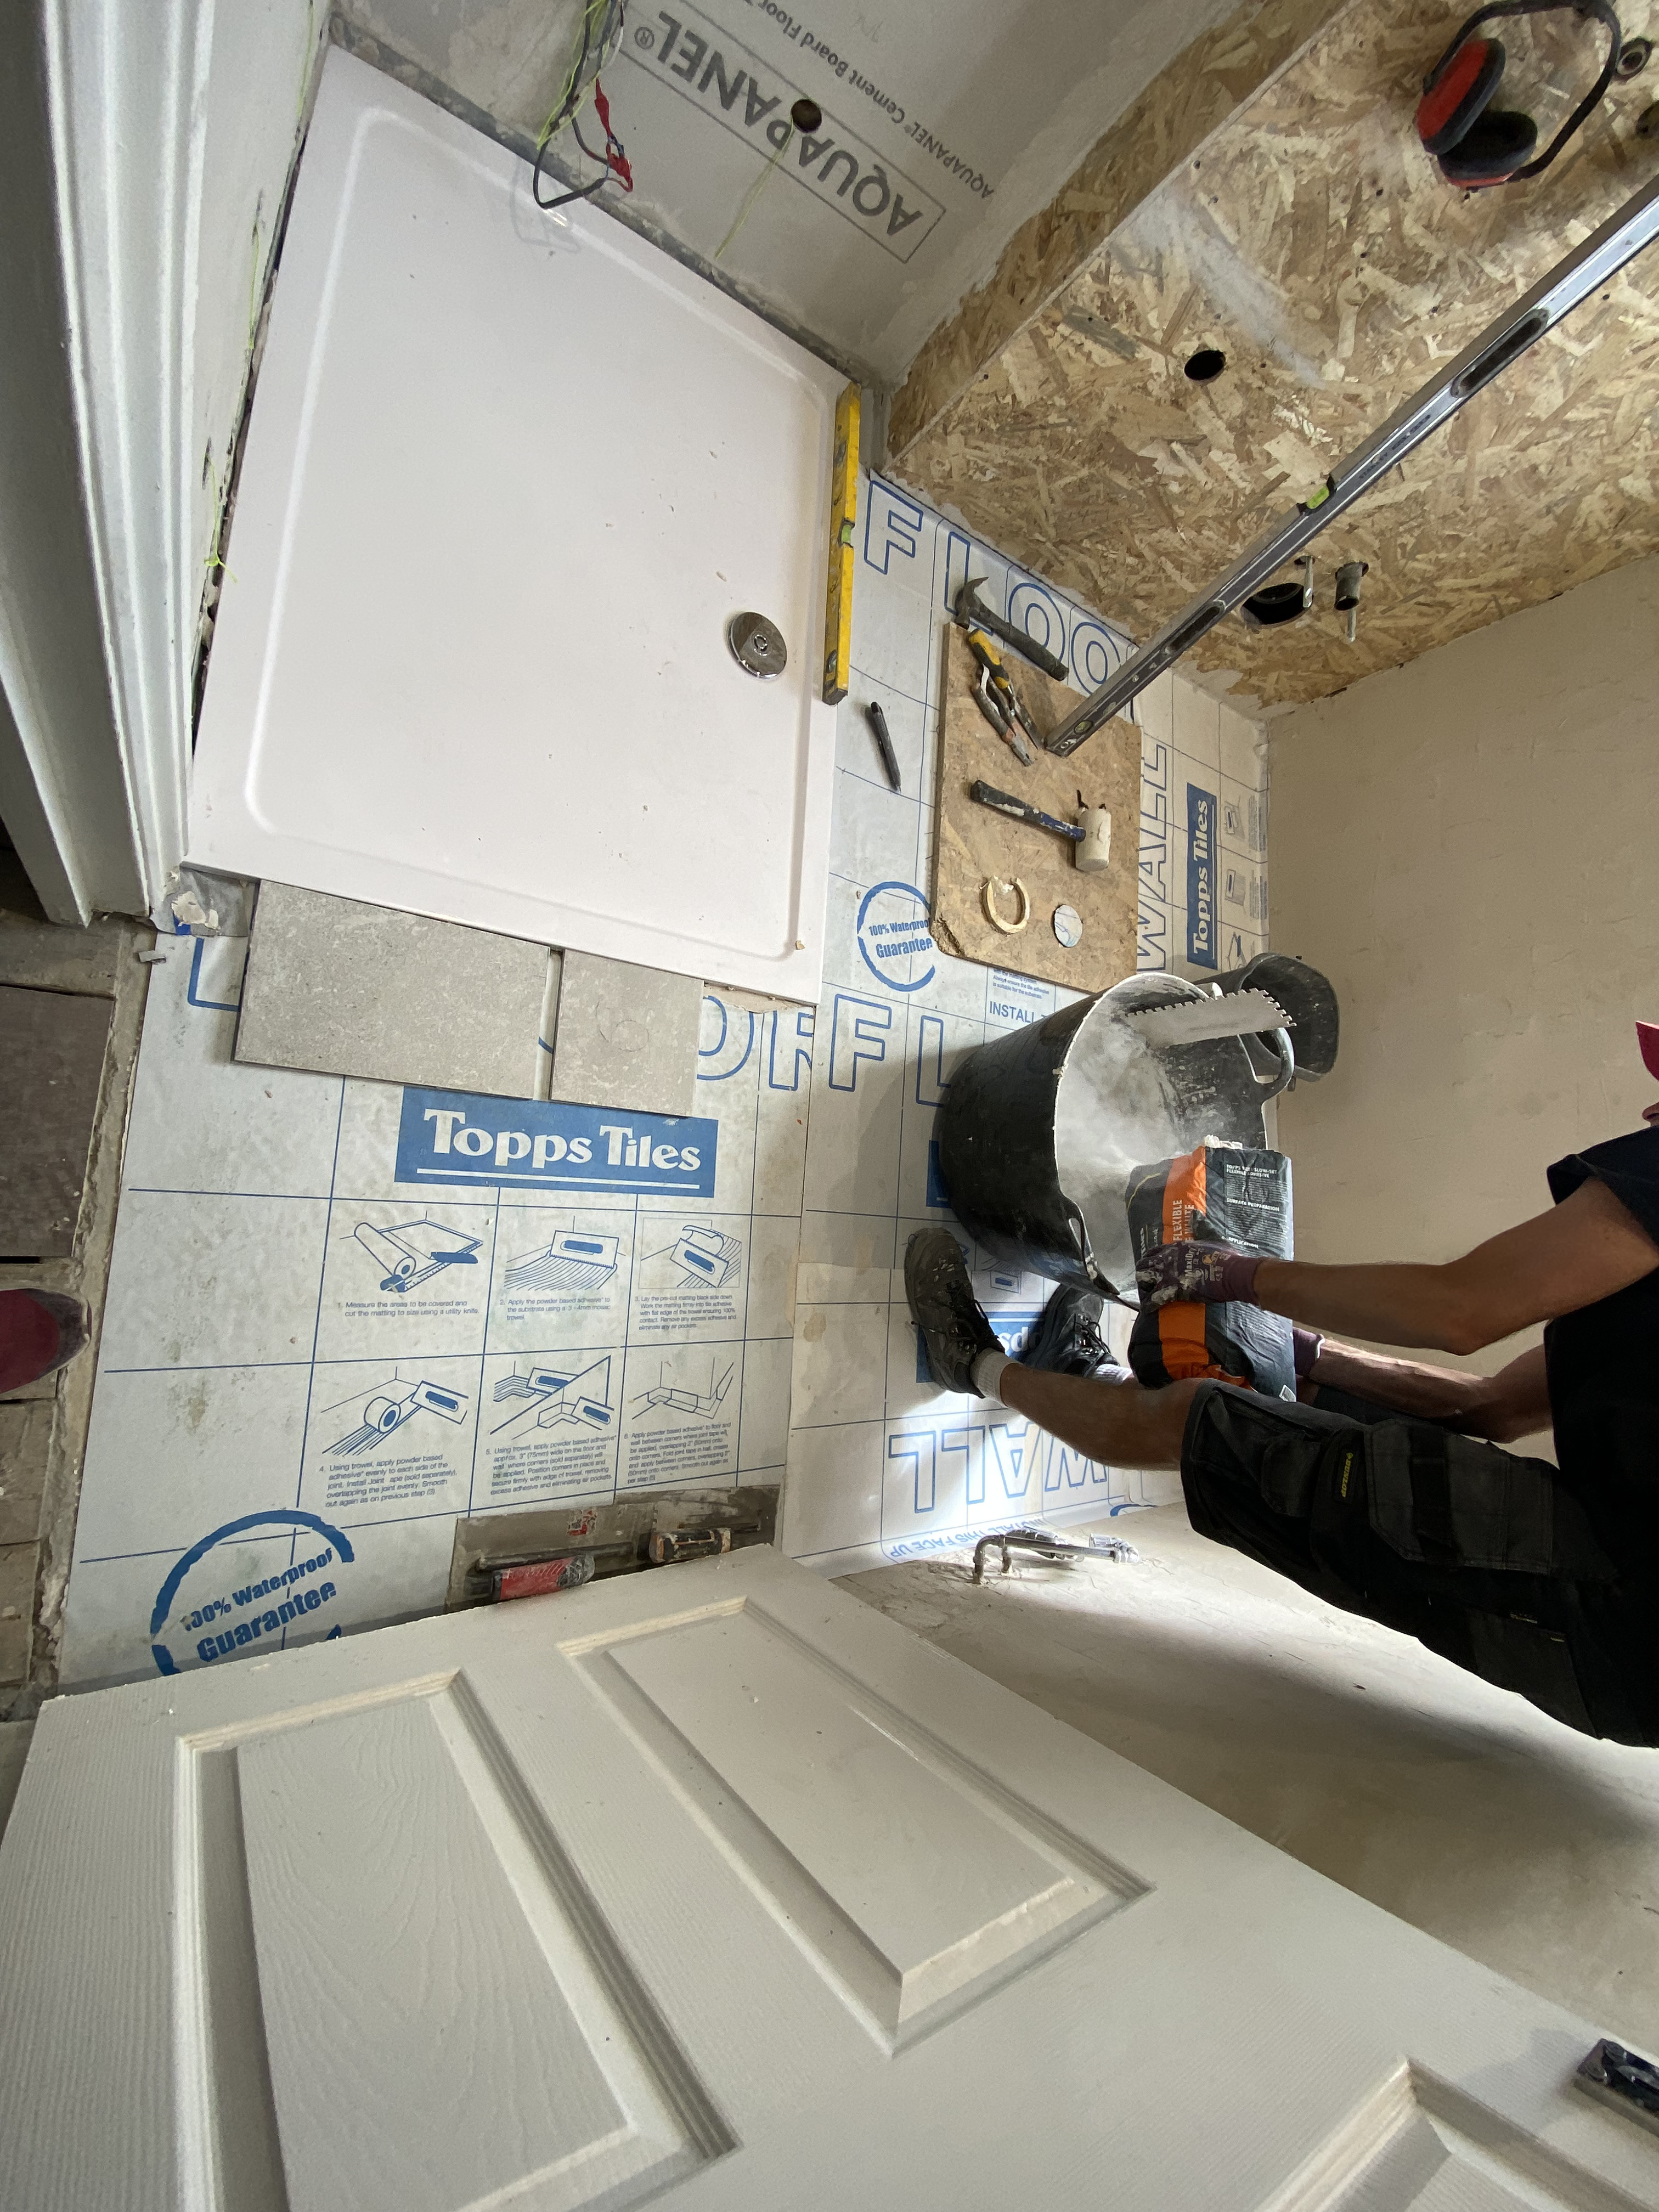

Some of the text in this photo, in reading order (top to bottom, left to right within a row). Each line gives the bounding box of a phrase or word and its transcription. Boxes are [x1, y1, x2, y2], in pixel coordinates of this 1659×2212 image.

[758, 0, 802, 40] Floor
[800, 32, 848, 77] Board
[849, 69, 906, 124] Cement
[1194, 799, 1210, 955] Topps Tiles
[868, 919, 928, 936] 100% Waterproo
[876, 938, 933, 958] Guarantee
[424, 1108, 702, 1171] Topps Tiles
[1248, 1201, 1280, 1212] PREPARATION
[1173, 1199, 1183, 1242] FLEXIBLE
[1228, 1236, 1259, 1249] APPLICATION
[550, 1440, 571, 1448] powder
[396, 1457, 421, 1465] powder
[365, 1469, 386, 1477] evenly
[528, 1466, 550, 1474] Position
[585, 1466, 609, 1475] removing
[326, 1488, 366, 1498] overlapping
[381, 1485, 396, 1493] joint
[422, 1479, 447, 1488] Smooth
[347, 1480, 366, 1488] Install
[404, 1473, 420, 1482] (sold
[552, 1478, 580, 1487] eliminating
[339, 1499, 358, 1507] again
[381, 1493, 409, 1502] previous
[890, 1545, 913, 1557] UP
[912, 1534, 957, 1551] FACE
[232, 1547, 332, 1606] Waterproof
[196, 1582, 337, 1662] Guarantee
